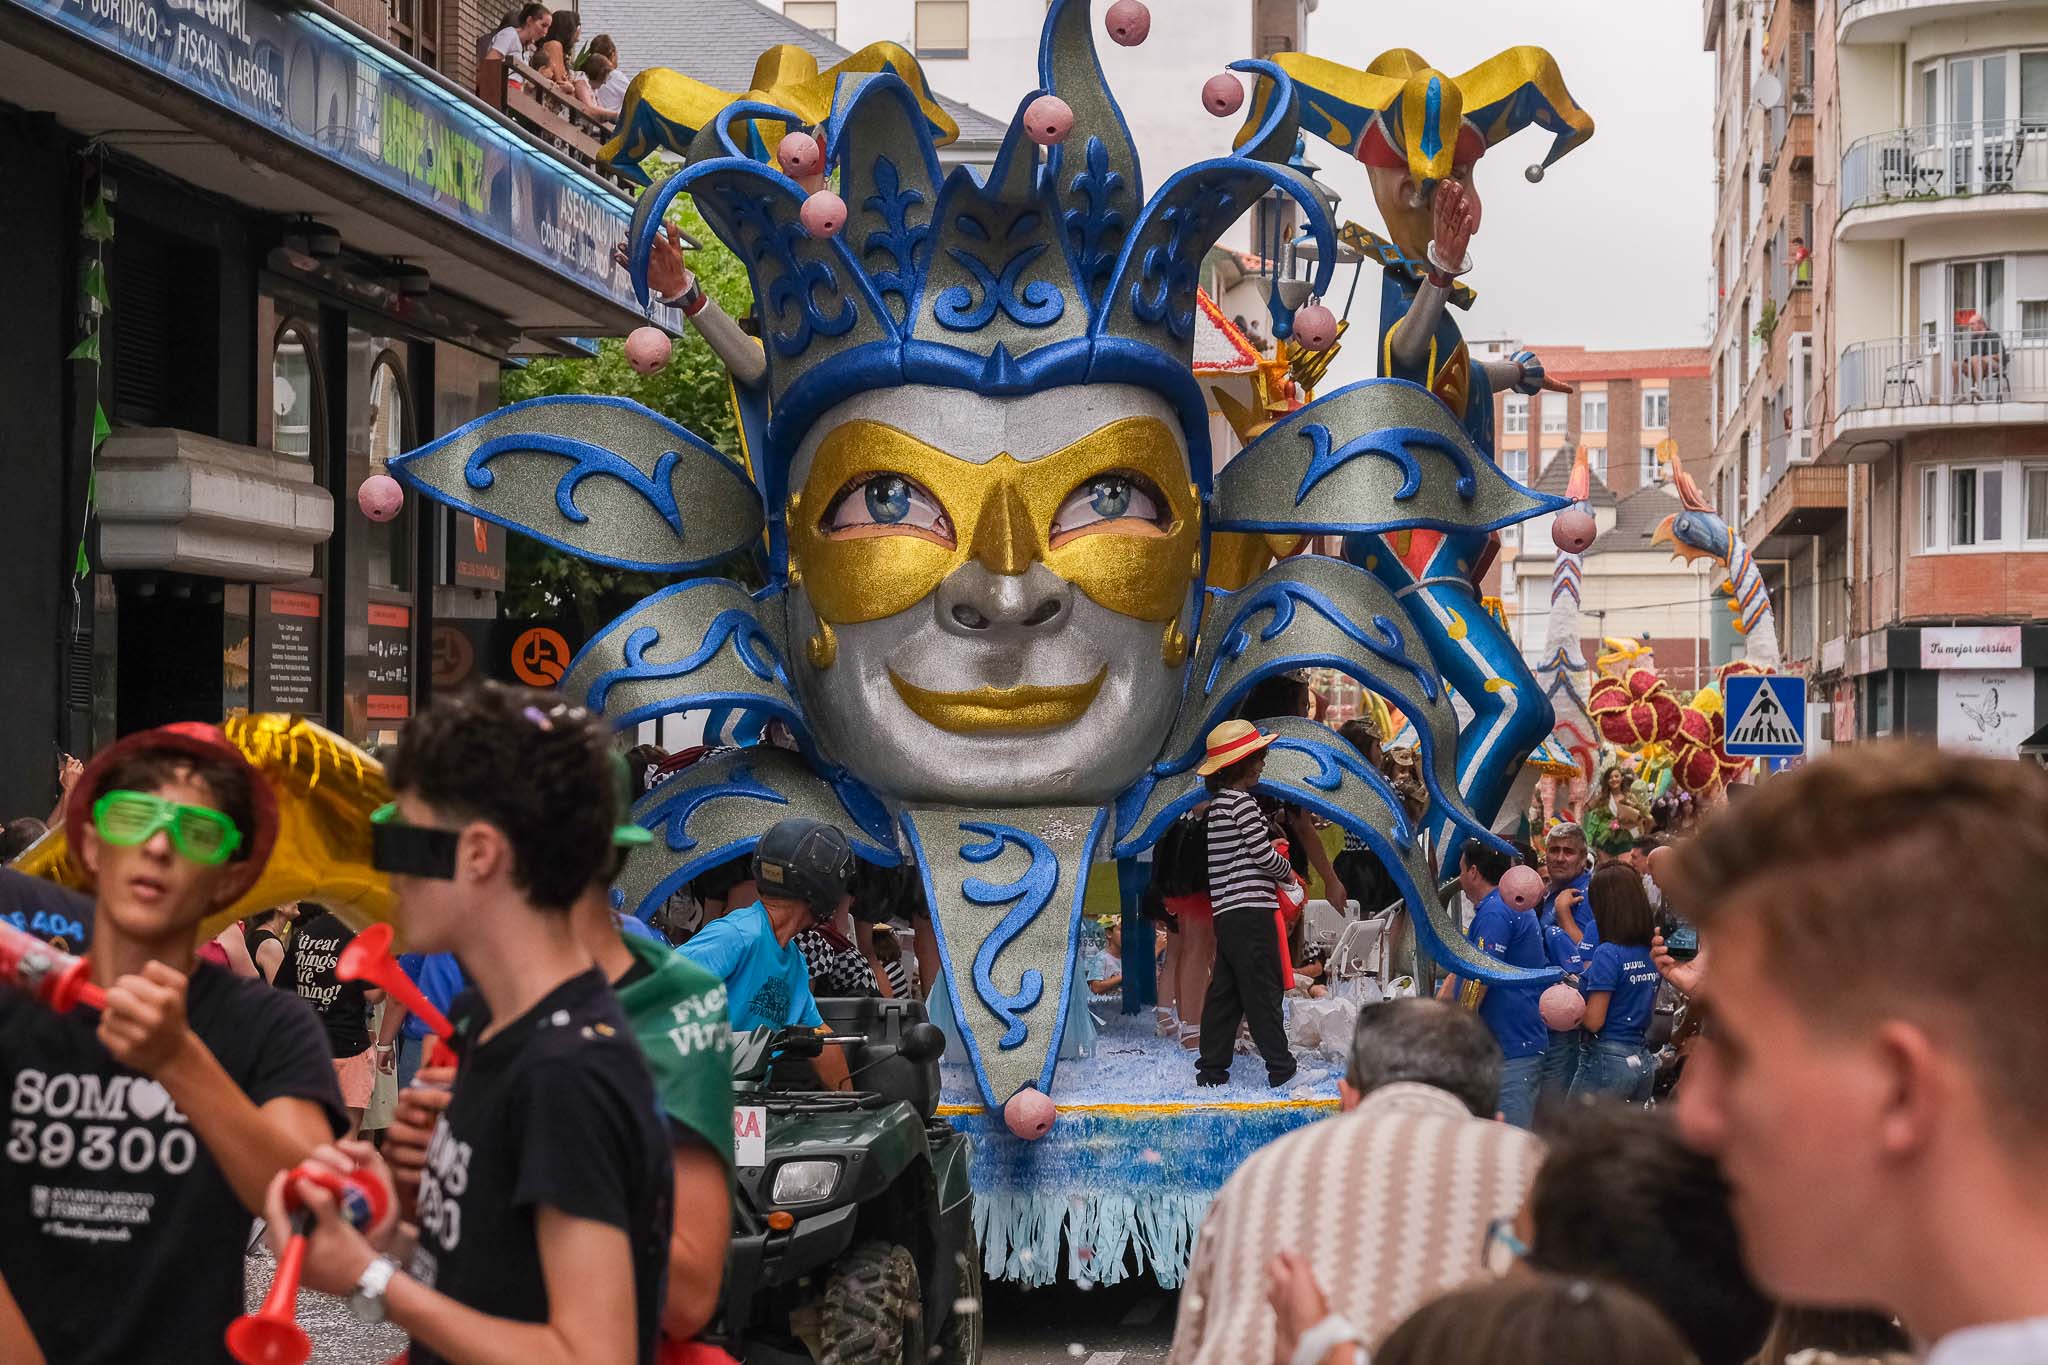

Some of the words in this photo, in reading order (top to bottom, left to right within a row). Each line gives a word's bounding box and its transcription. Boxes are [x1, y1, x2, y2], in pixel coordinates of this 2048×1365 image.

[229, 51, 282, 108] LABORAL
[1931, 642, 1944, 655] Tu
[1945, 643, 1973, 658] mejor
[1975, 642, 2012, 654] versión
[31, 909, 85, 943] 404
[6, 1118, 197, 1175] 39300
